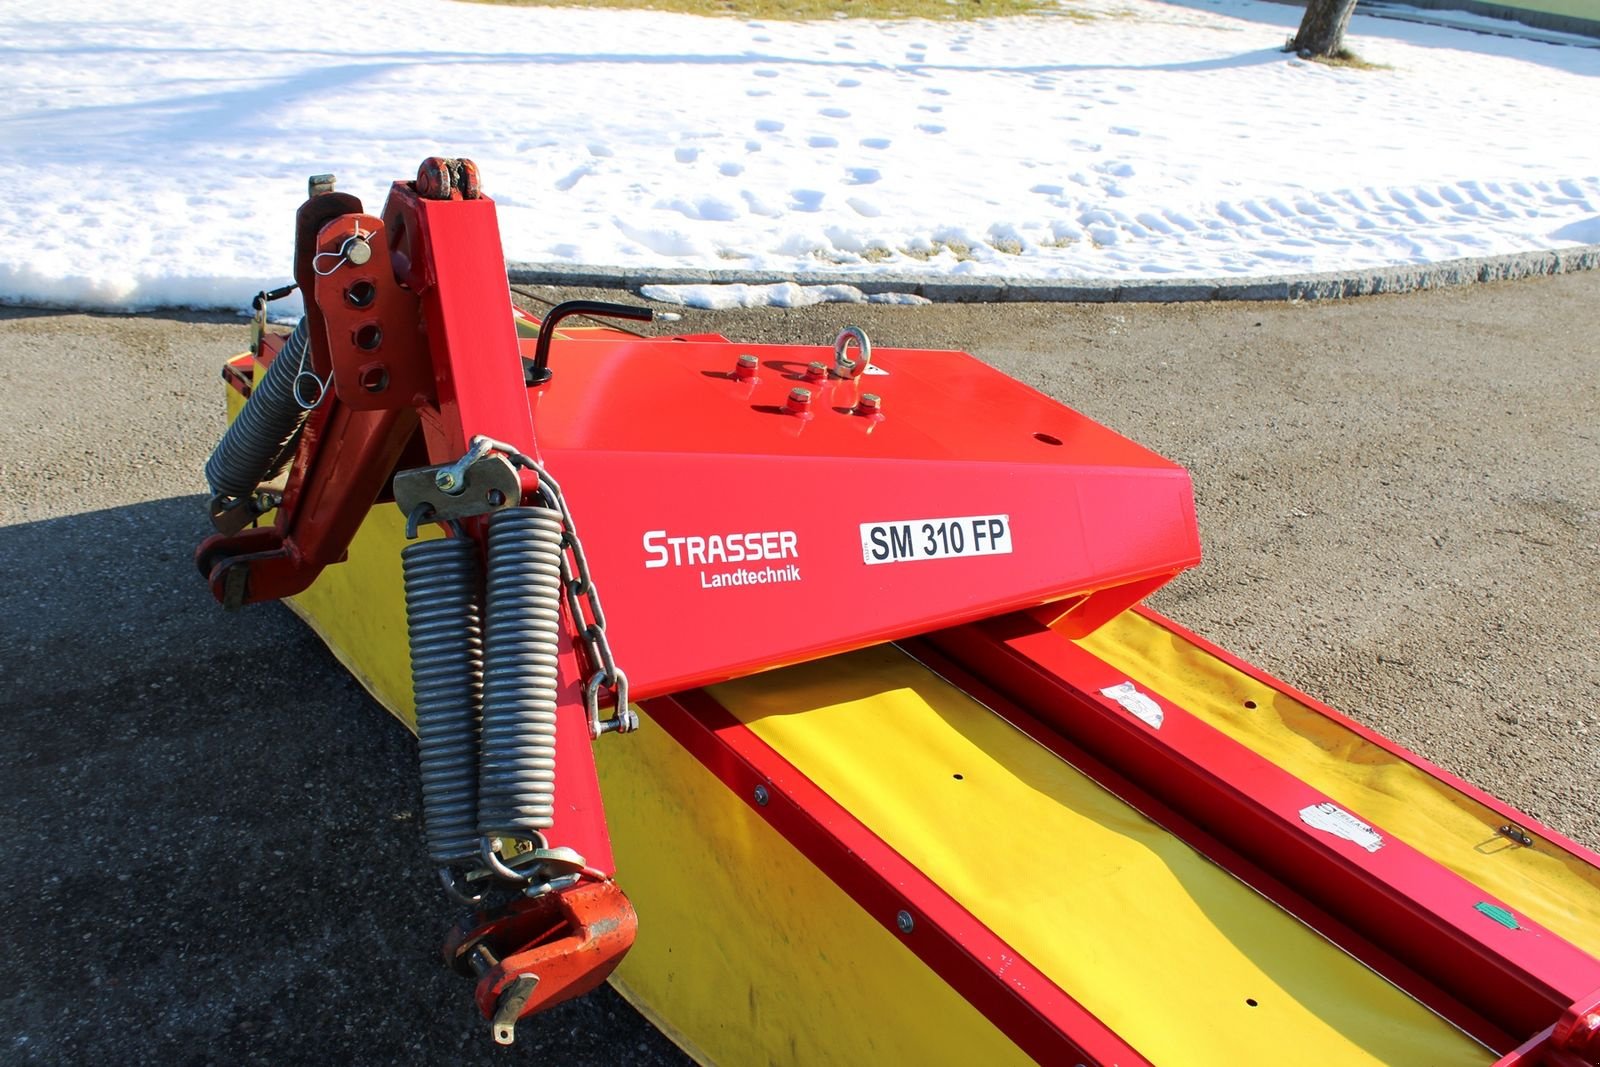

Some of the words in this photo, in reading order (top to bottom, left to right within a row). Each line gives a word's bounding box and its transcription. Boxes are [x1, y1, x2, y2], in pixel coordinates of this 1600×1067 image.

[643, 530, 799, 568] STRASSER
[870, 526, 914, 560] SM
[922, 521, 964, 556] 310
[972, 519, 1005, 552] FP
[701, 564, 801, 588] Landtechnik
